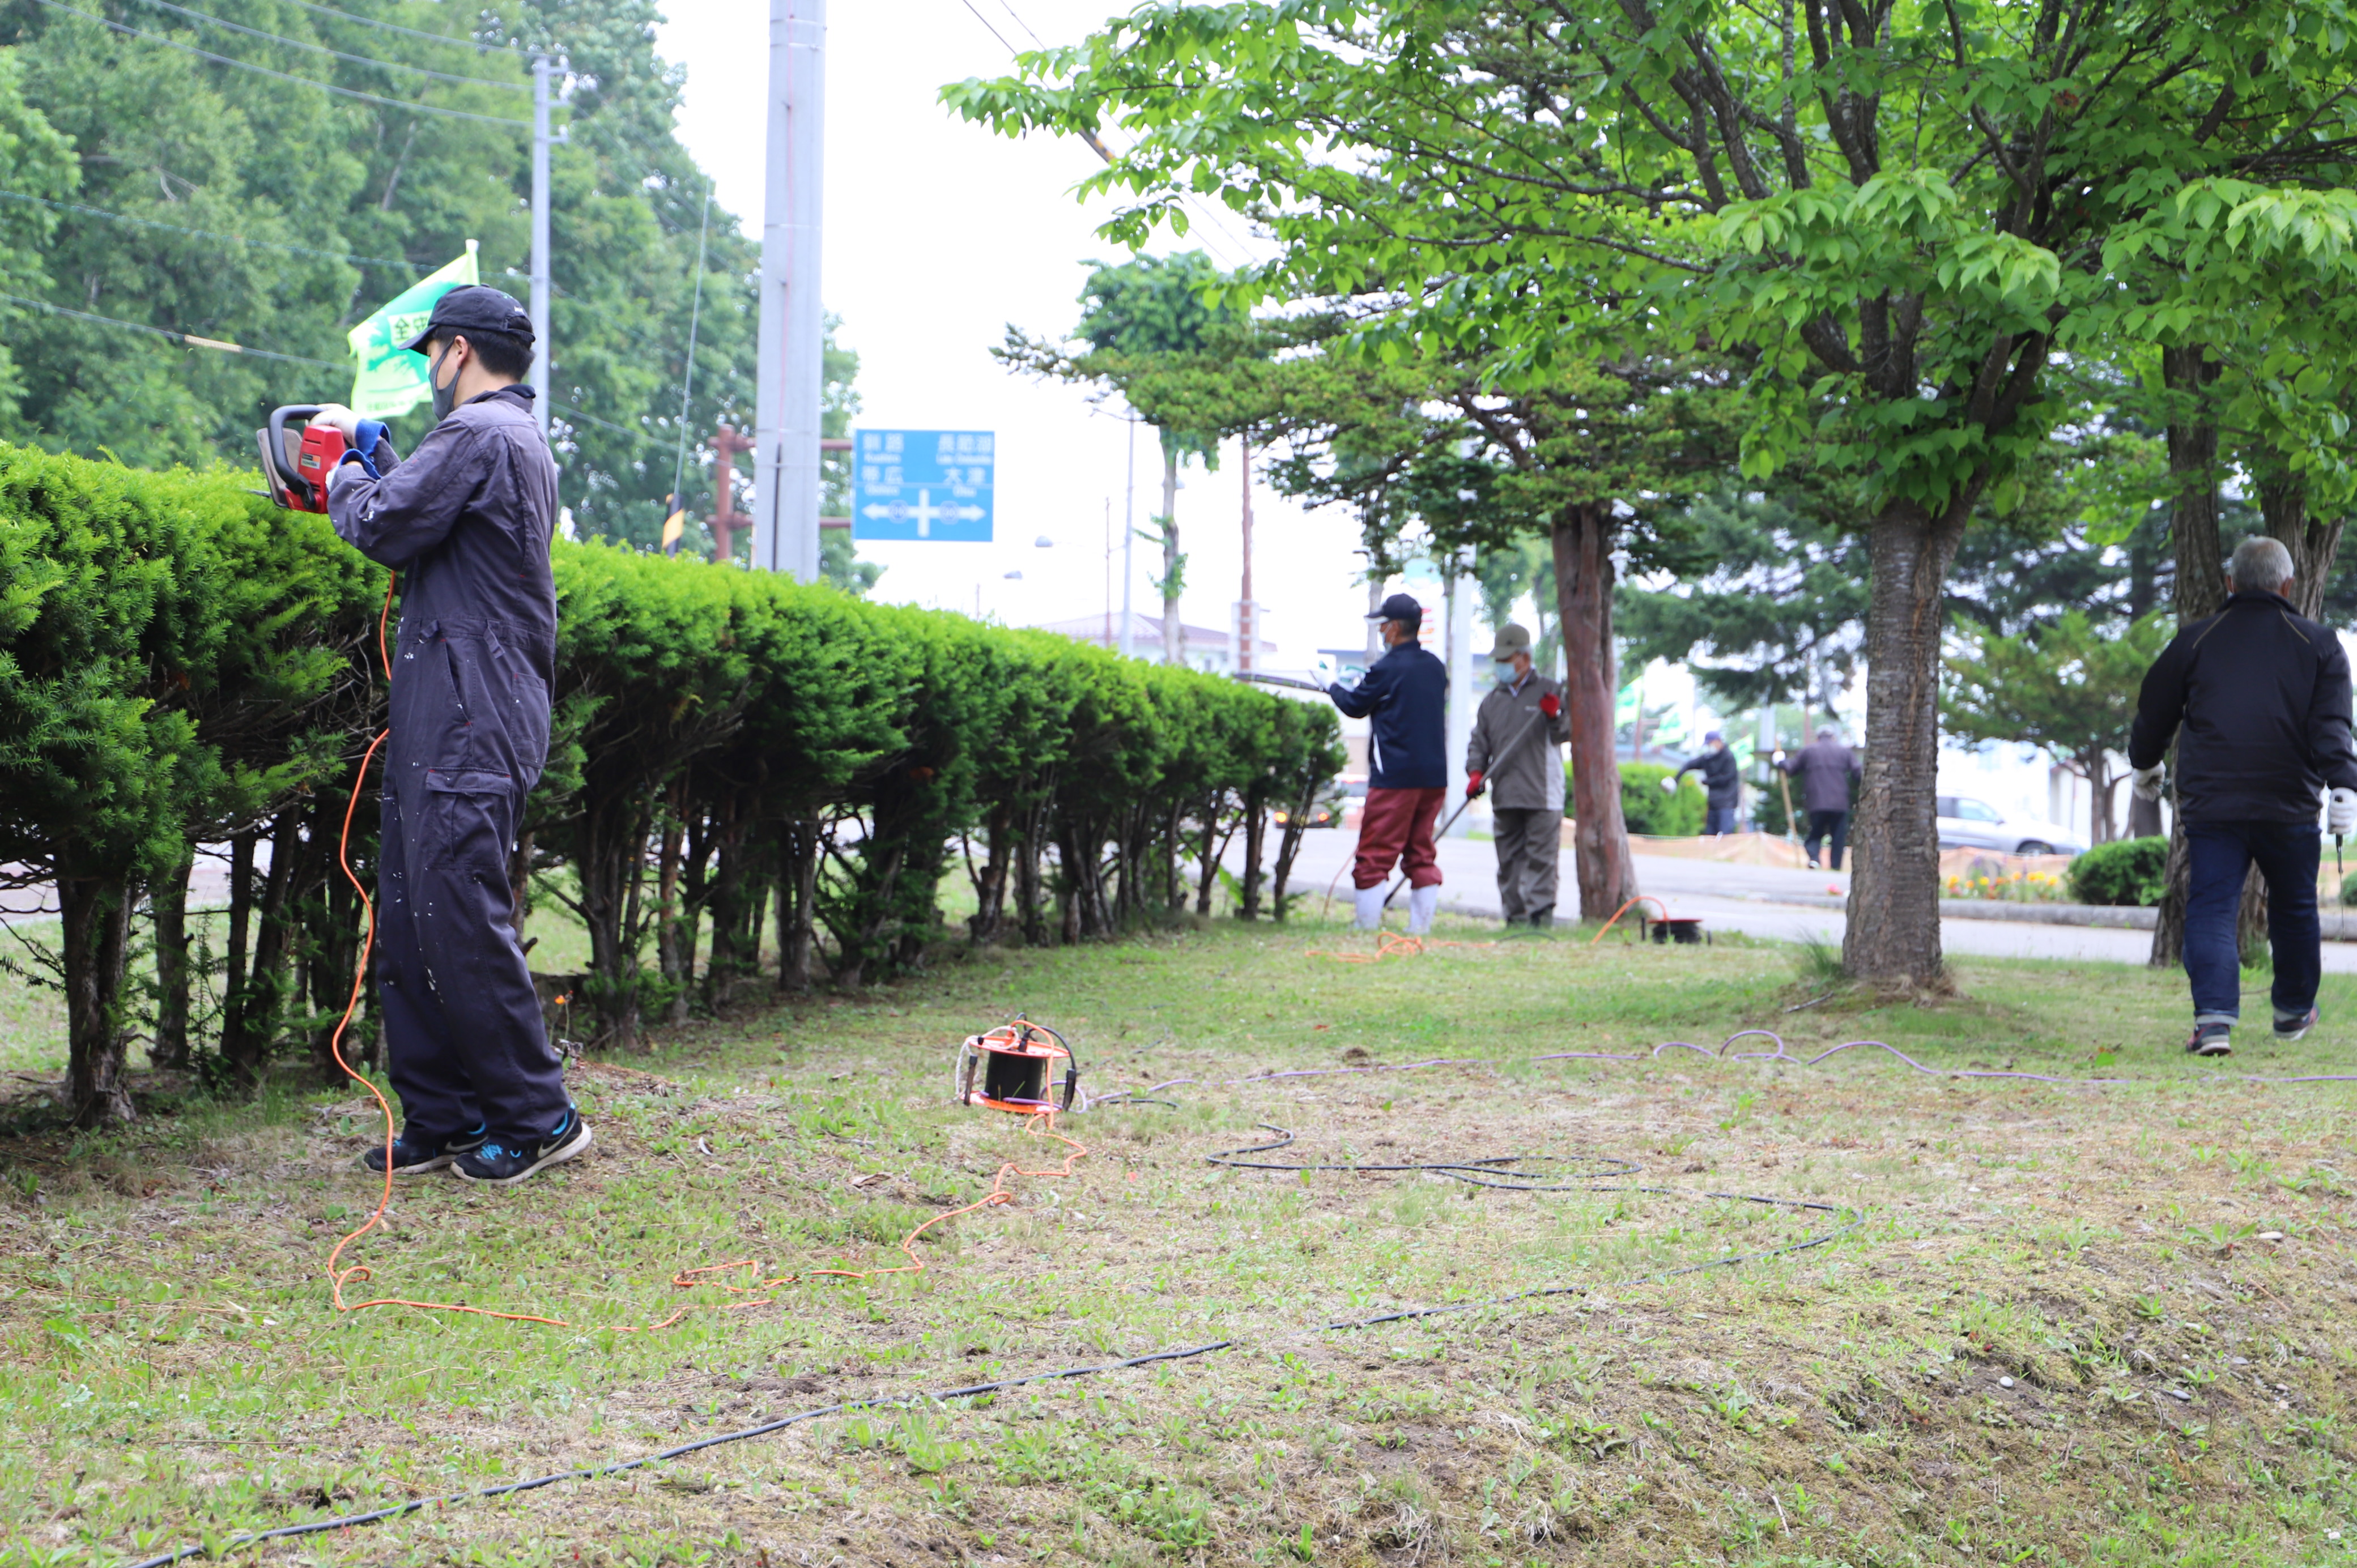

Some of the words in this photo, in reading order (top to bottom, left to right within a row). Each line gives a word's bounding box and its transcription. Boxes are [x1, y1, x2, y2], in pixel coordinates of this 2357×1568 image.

[863, 433, 904, 453] 釧路
[864, 453, 901, 464] Kushiro
[861, 466, 904, 485] 帯広
[943, 467, 986, 485] 大津
[865, 484, 900, 496] Obihiro
